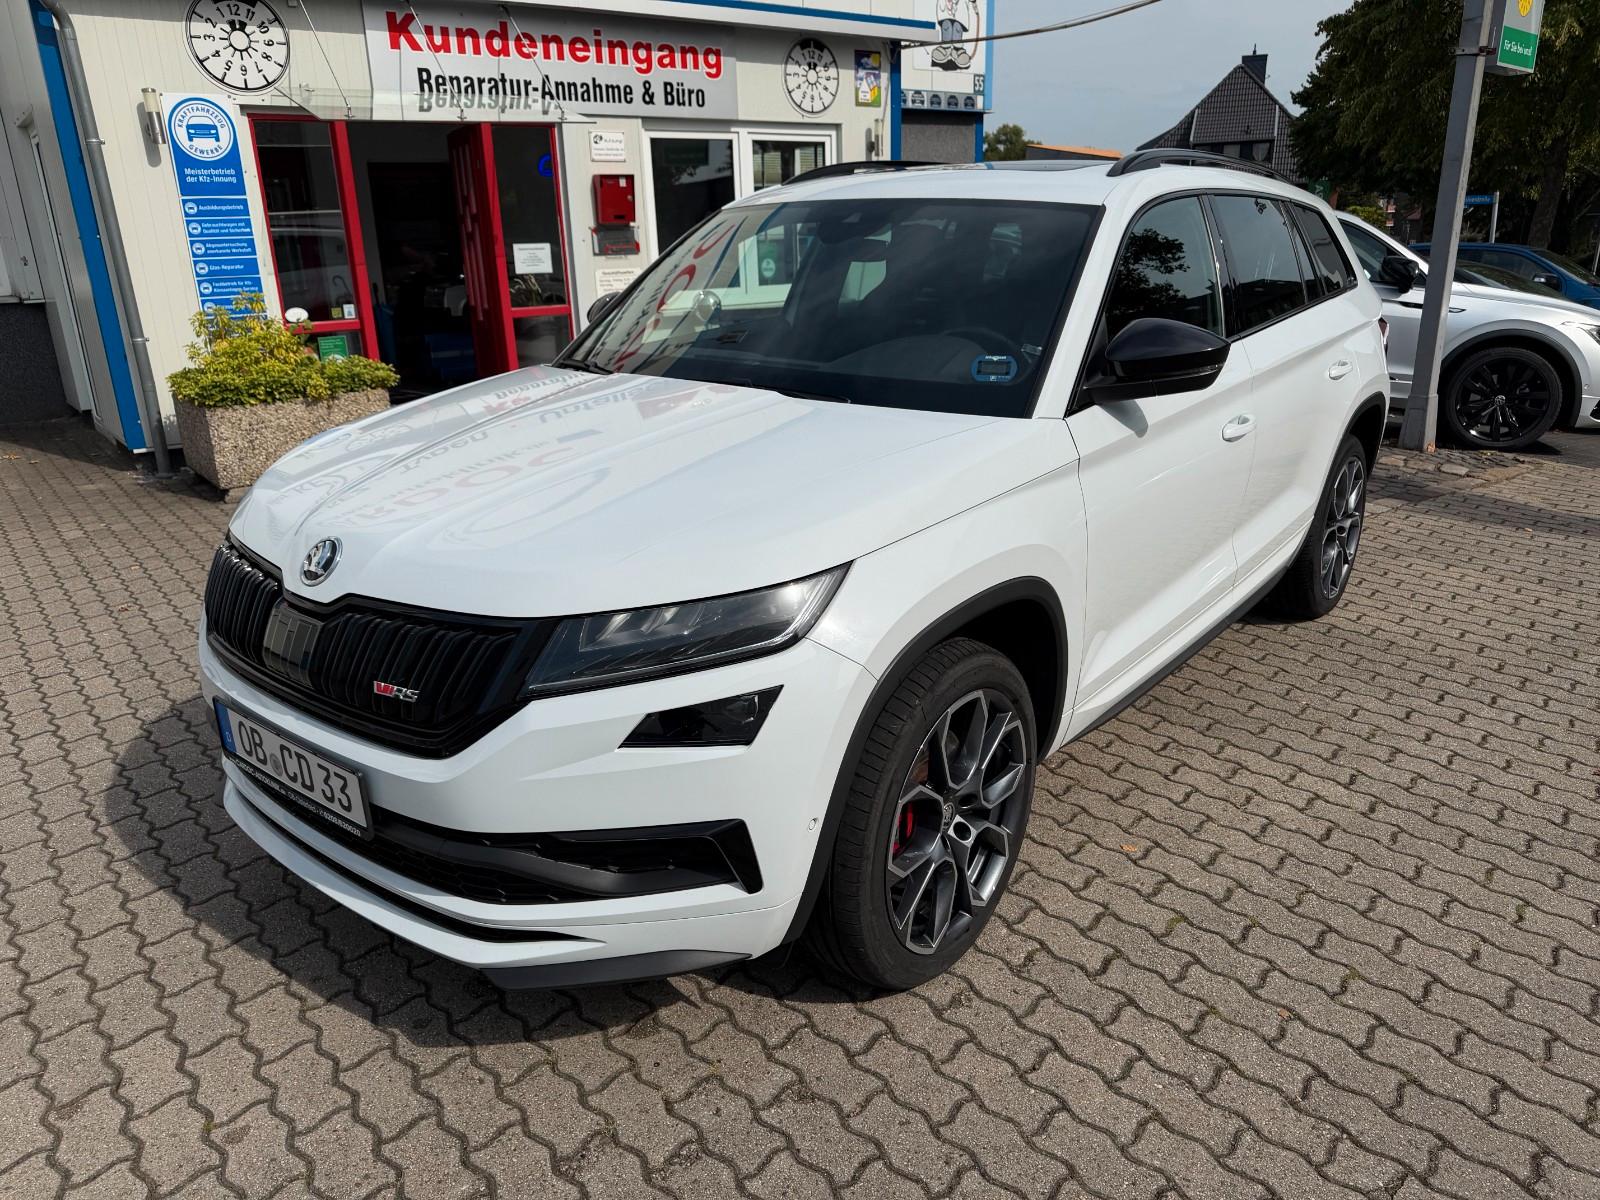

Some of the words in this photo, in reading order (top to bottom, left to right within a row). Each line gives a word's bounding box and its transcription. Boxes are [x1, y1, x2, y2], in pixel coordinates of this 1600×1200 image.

[215, 6, 225, 18] 1
[227, 3, 241, 16] 12
[246, 8, 255, 21] 11
[204, 17, 218, 29] 2
[257, 20, 270, 34] 10
[203, 33, 216, 42] 3
[263, 38, 275, 47] 9
[385, 10, 722, 79] Kundeneingang
[210, 49, 221, 57] 4
[260, 51, 273, 62] 8
[223, 59, 233, 71] 5
[240, 64, 248, 76] 6
[254, 61, 264, 73] 7
[416, 67, 634, 105] Reparatur-Annahme
[641, 79, 656, 105] &
[662, 80, 706, 108] Büro
[974, 76, 984, 91] 55
[177, 105, 226, 129] KRAFTFAHRZEUG
[188, 143, 223, 155] GEWERBE
[186, 175, 198, 183] der
[199, 175, 237, 184] Kfz-Innung
[238, 720, 268, 766] OB
[279, 743, 315, 792] CD
[317, 762, 353, 813] 33
